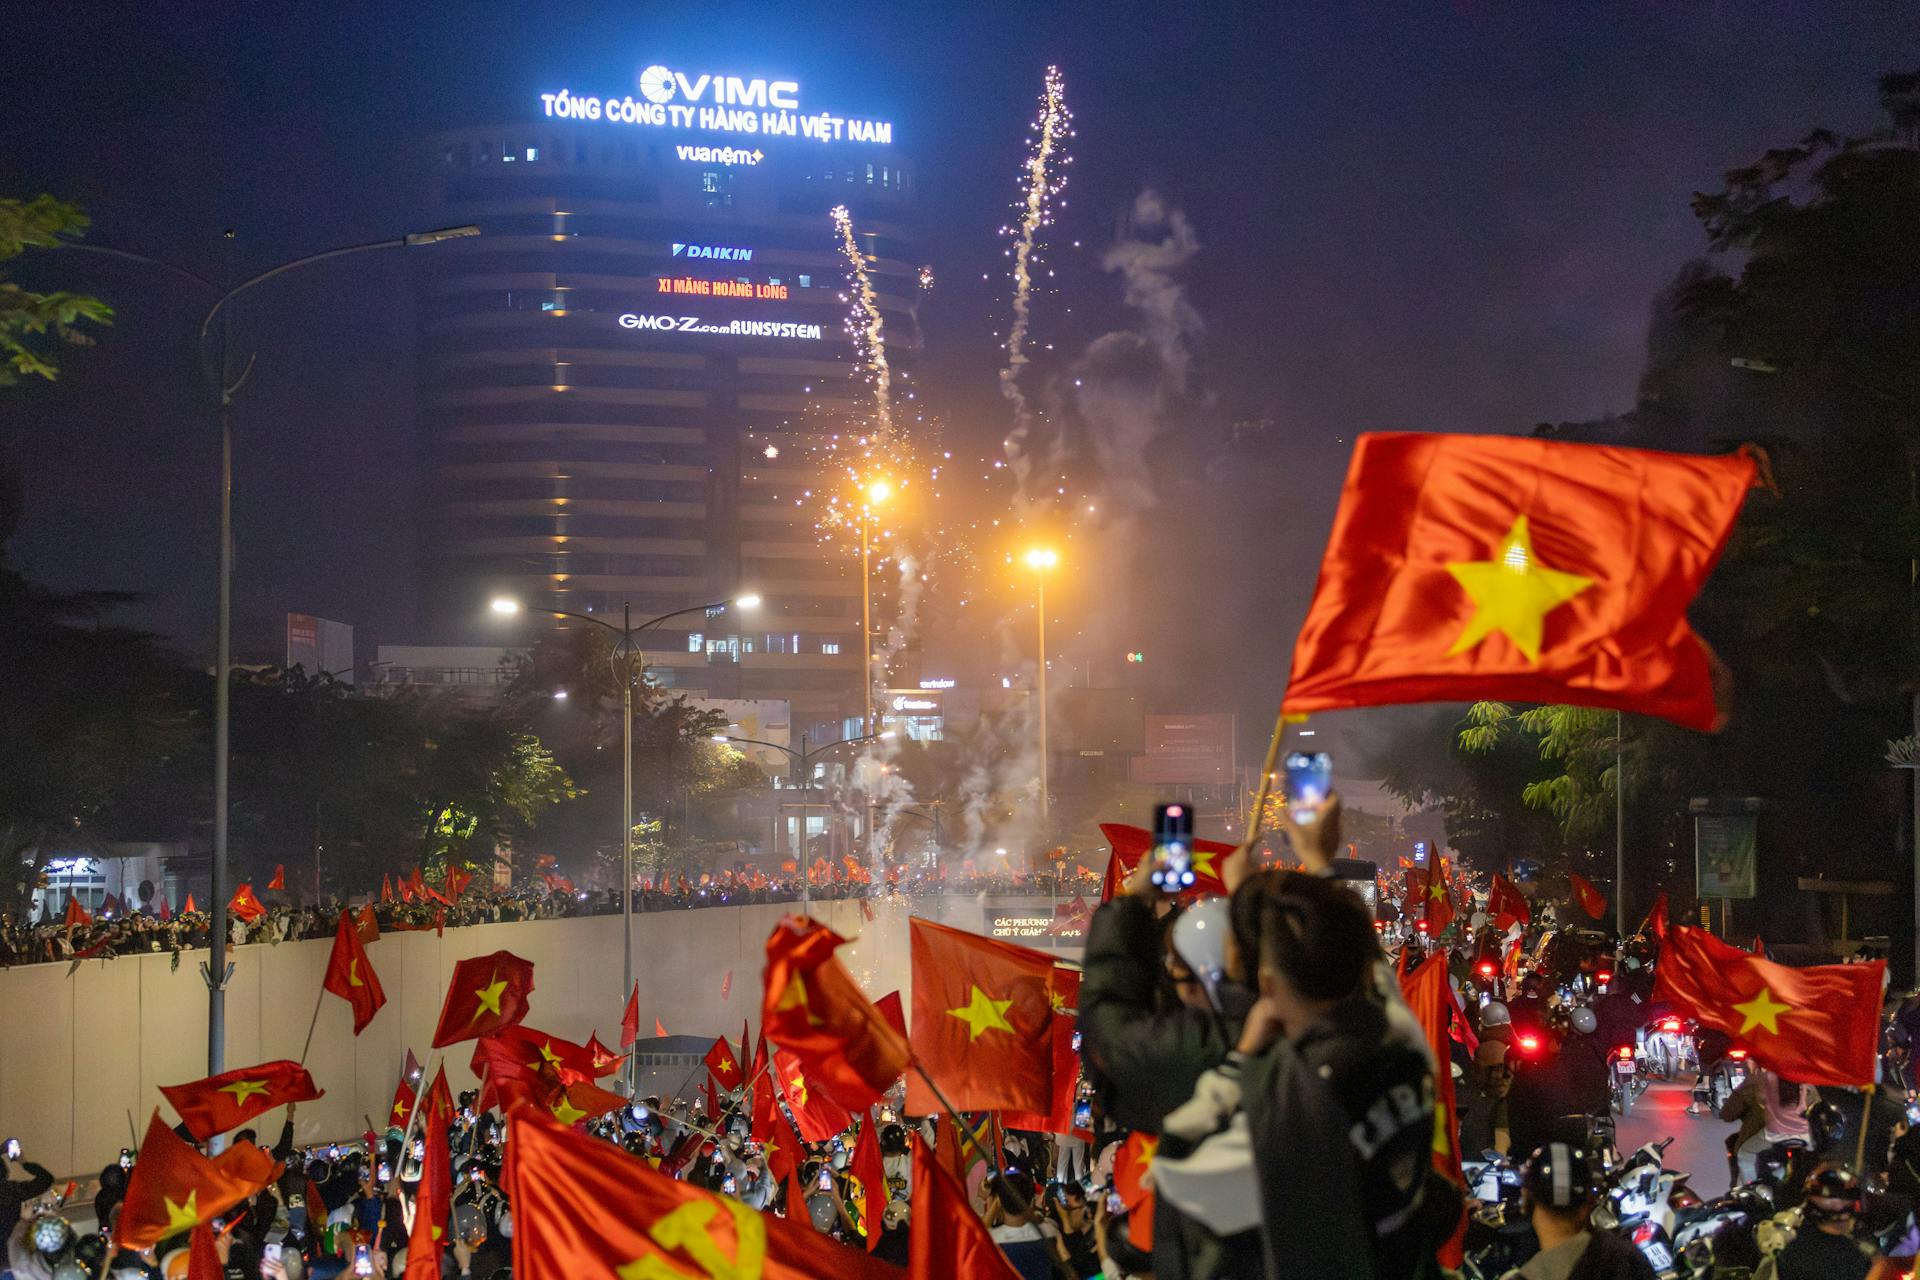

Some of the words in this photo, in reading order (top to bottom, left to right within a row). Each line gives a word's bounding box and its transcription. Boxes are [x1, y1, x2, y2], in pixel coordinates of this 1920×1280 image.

[541, 88, 601, 120] TỔNG
[605, 96, 667, 126] CÔNG
[668, 105, 696, 128] TY
[700, 105, 758, 134] HÀNG
[762, 109, 797, 136] HẢI
[800, 112, 845, 143] VIỆT
[848, 119, 892, 143] NAM
[687, 245, 753, 261] DAIKIN
[658, 278, 671, 293] XI
[674, 277, 710, 295] MĂNG
[713, 280, 753, 298] HOÀNG
[756, 284, 788, 300] LONG
[730, 319, 822, 340] RUNSYSTEM
[993, 927, 1011, 936] CHÚ
[994, 918, 1012, 927] CÁC
